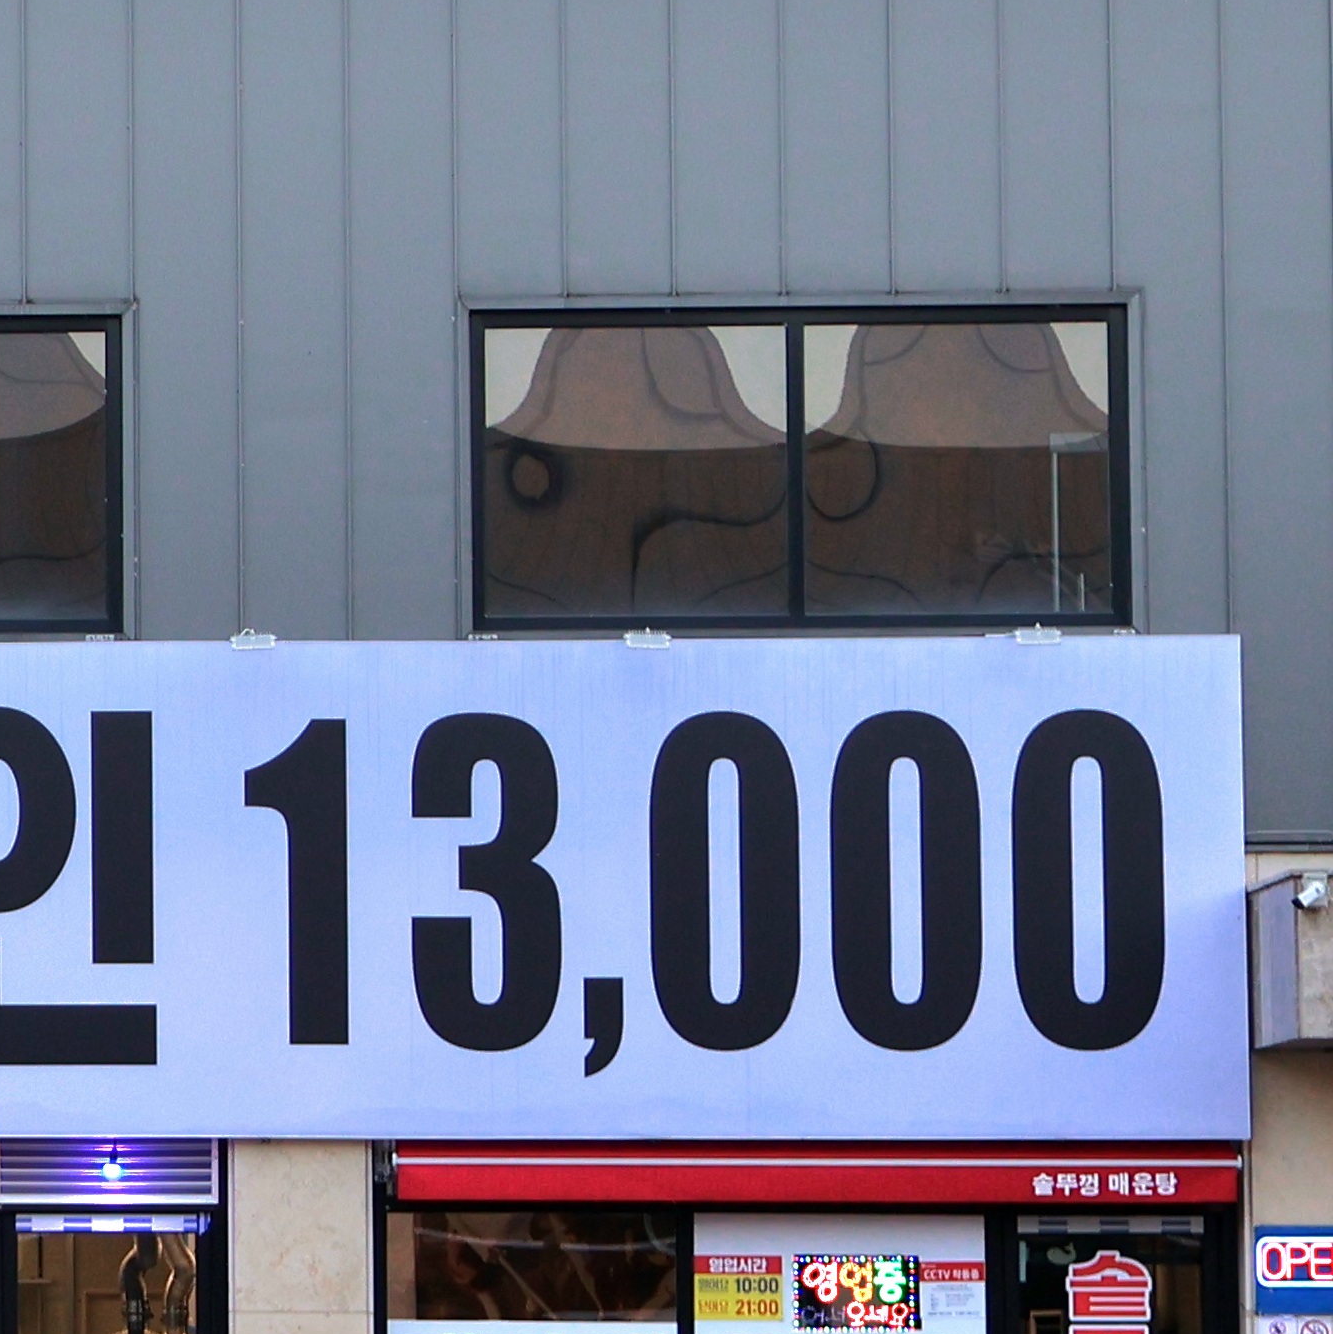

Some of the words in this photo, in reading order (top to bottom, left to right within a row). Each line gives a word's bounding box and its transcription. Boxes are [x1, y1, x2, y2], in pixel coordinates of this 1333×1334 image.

[244, 708, 1165, 1078] 13,000
[1108, 1171, 1178, 1196] 매운탕
[801, 1260, 907, 1304] 영업중
[923, 1269, 950, 1280] CCTV
[736, 1277, 779, 1294] 10:00
[736, 1298, 779, 1316] 21:00
